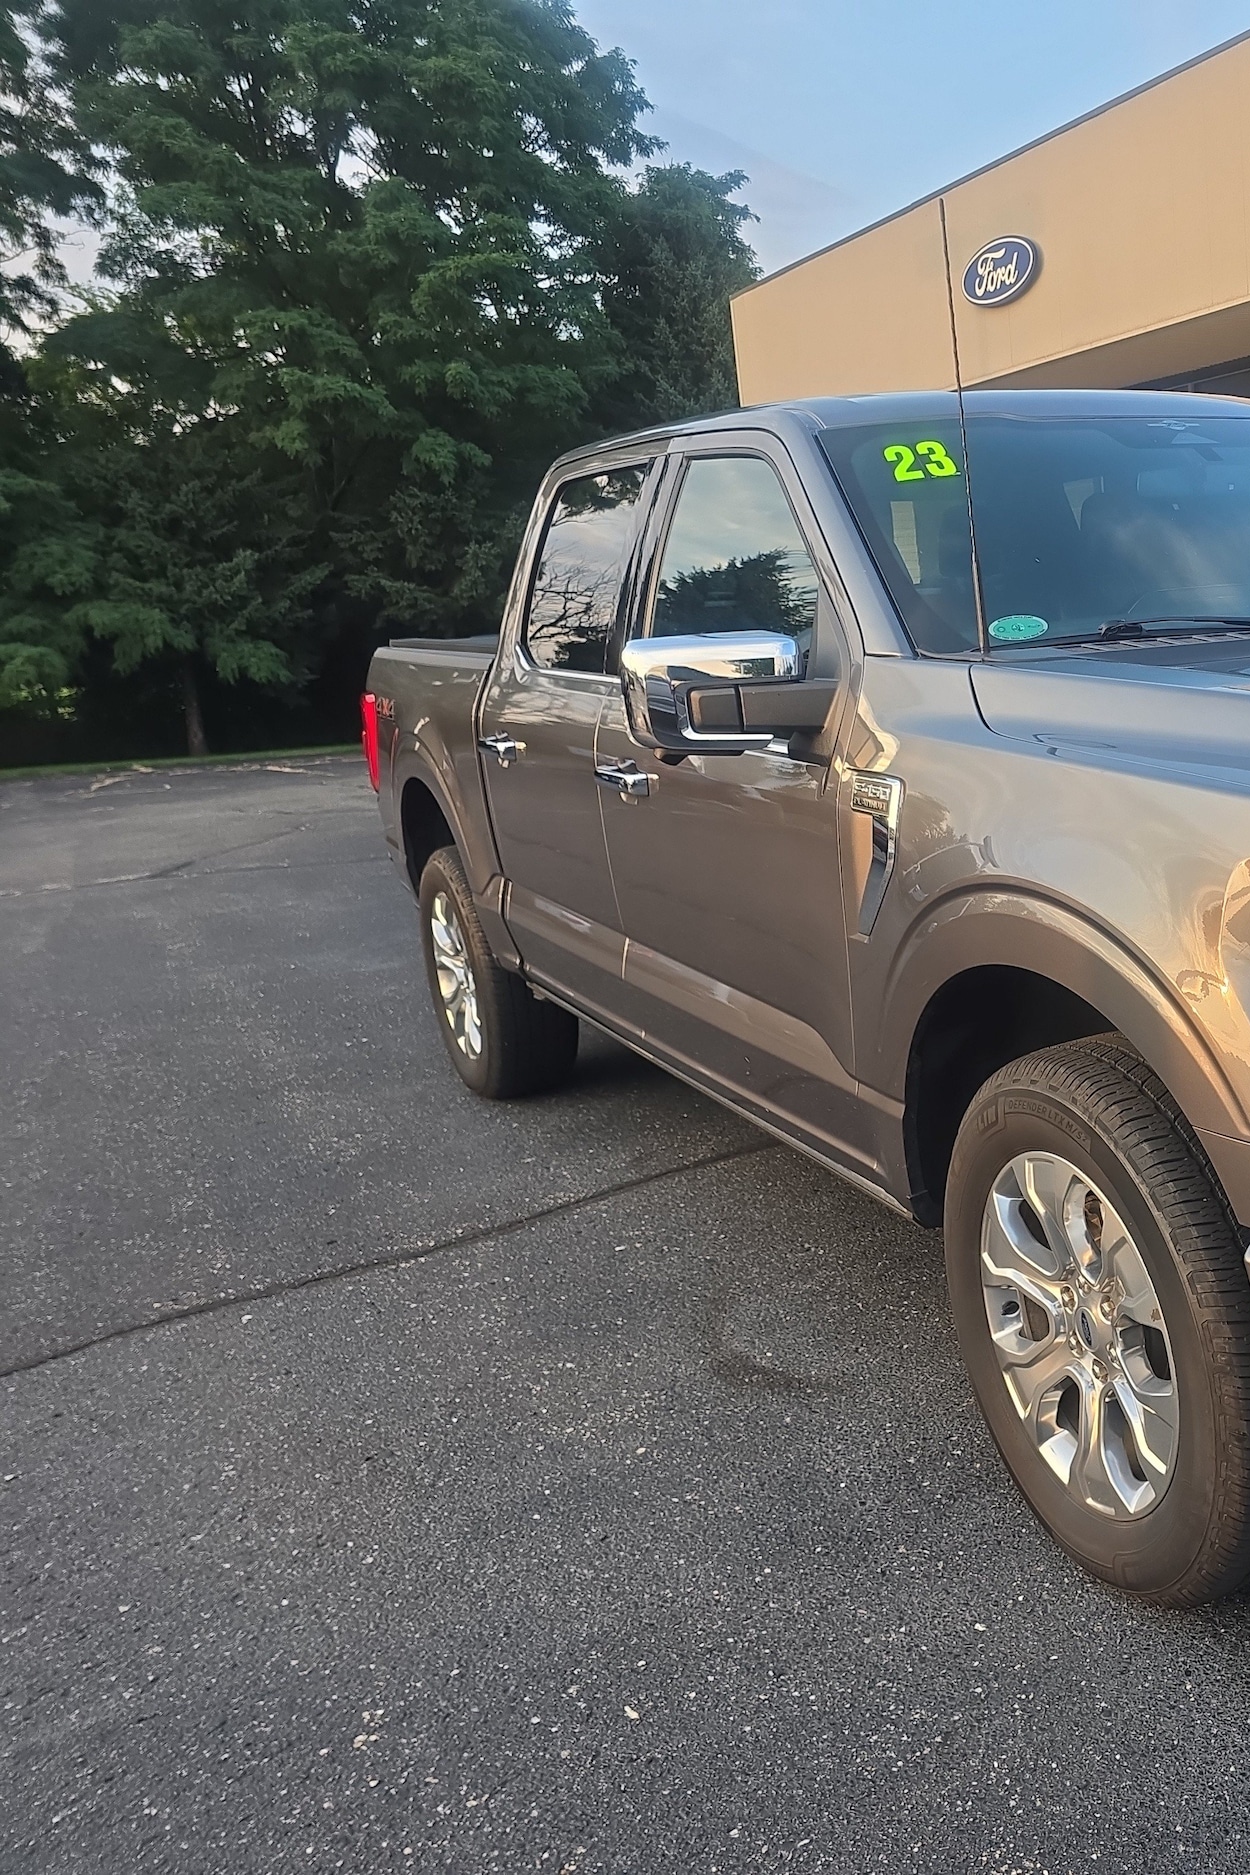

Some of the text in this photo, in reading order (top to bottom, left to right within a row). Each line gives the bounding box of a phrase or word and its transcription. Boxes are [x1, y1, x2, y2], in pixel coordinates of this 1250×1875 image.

[975, 247, 1019, 297] Ford
[883, 440, 958, 482] 23
[1008, 1099, 1048, 1115] DEFENDER
[1047, 1109, 1066, 1126] LTX
